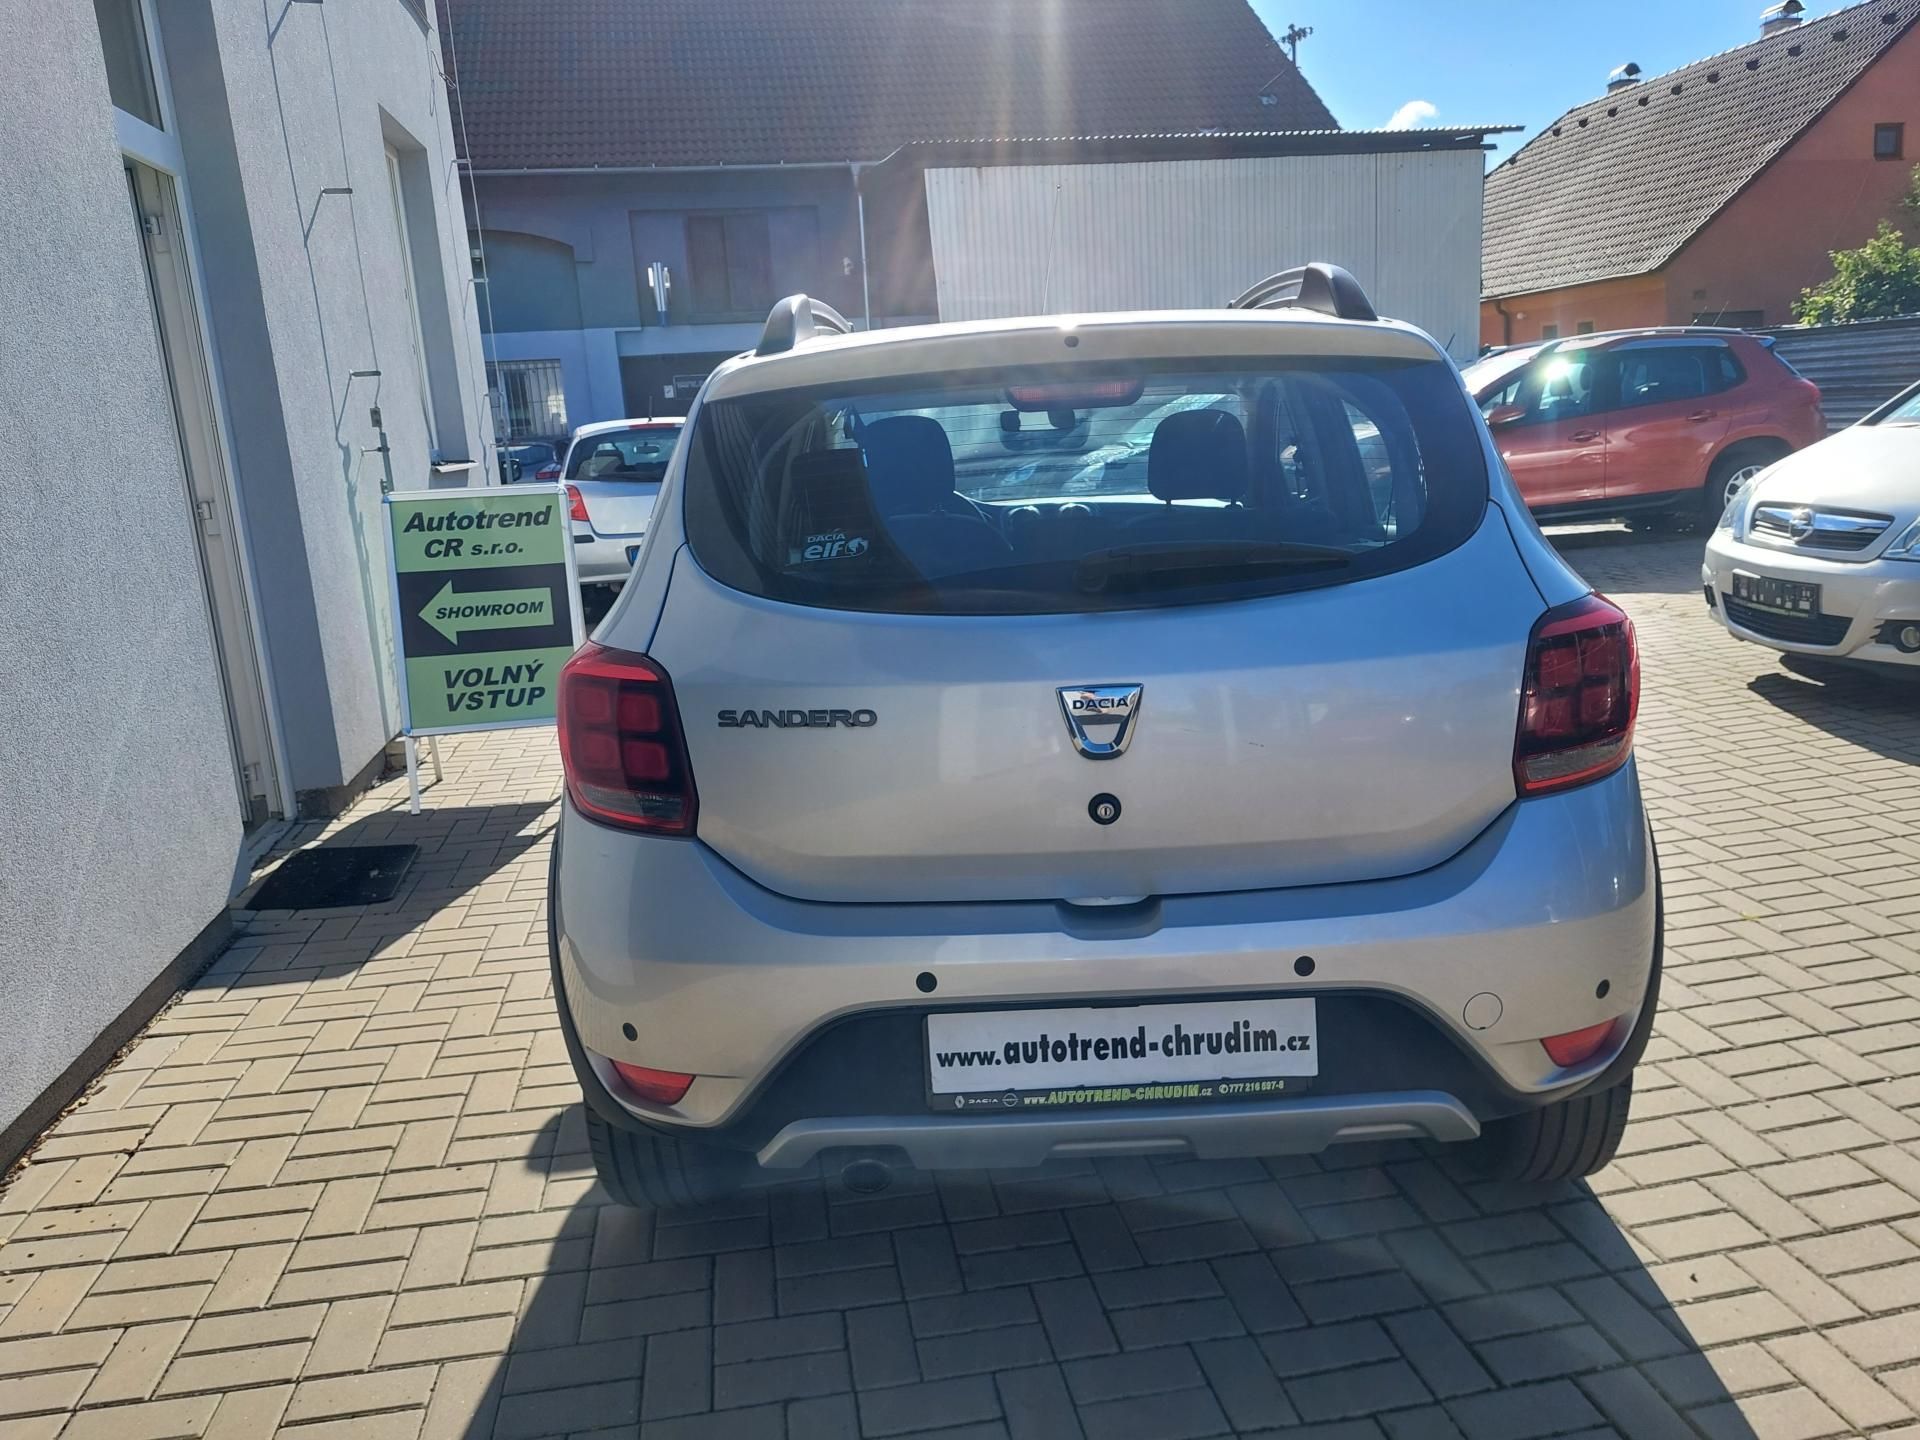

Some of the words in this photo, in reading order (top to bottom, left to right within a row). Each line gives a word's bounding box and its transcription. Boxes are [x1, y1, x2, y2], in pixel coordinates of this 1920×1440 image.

[404, 506, 551, 532] Autotrend
[424, 538, 463, 557] CR
[471, 542, 523, 555] s.r.o.
[807, 533, 845, 543] DACIA
[804, 541, 845, 558] elf
[436, 601, 543, 619] SHOWROOM
[444, 660, 543, 688] VOLNÝ
[446, 686, 545, 712] VSTUP
[1073, 698, 1128, 709] DACIA
[718, 709, 877, 728] SANDERO
[937, 1020, 1310, 1067] www.autotrend-chrudim.cz
